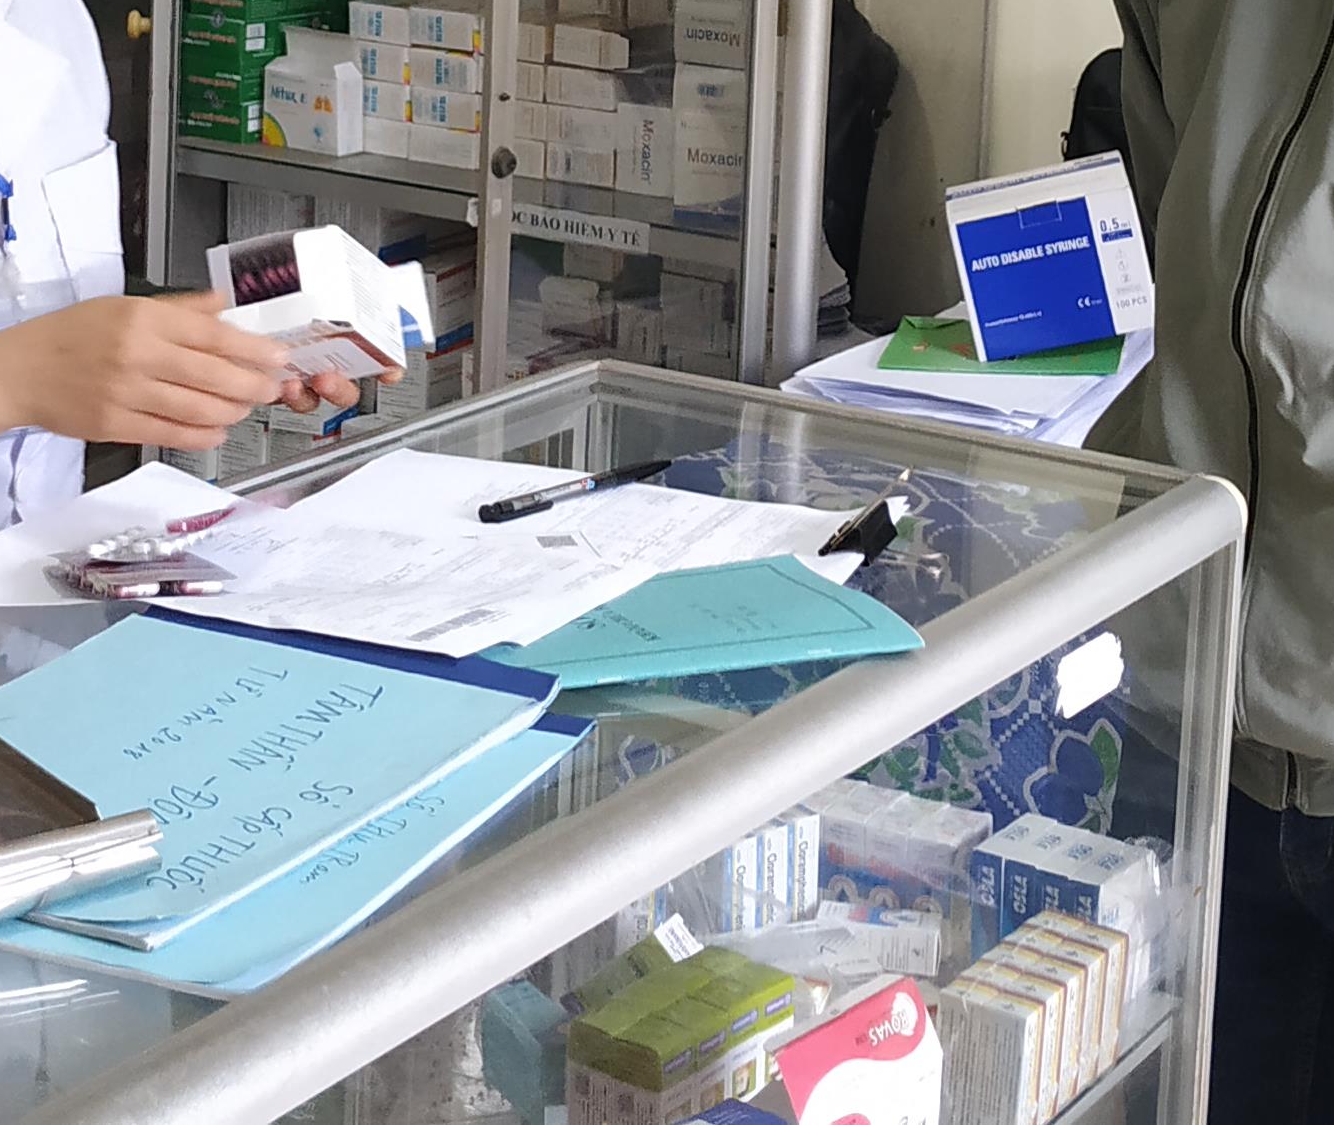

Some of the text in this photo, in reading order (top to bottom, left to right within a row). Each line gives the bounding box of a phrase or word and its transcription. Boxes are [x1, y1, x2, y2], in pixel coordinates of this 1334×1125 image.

[971, 236, 1090, 272] AUTO DISABLE SYRINGE
